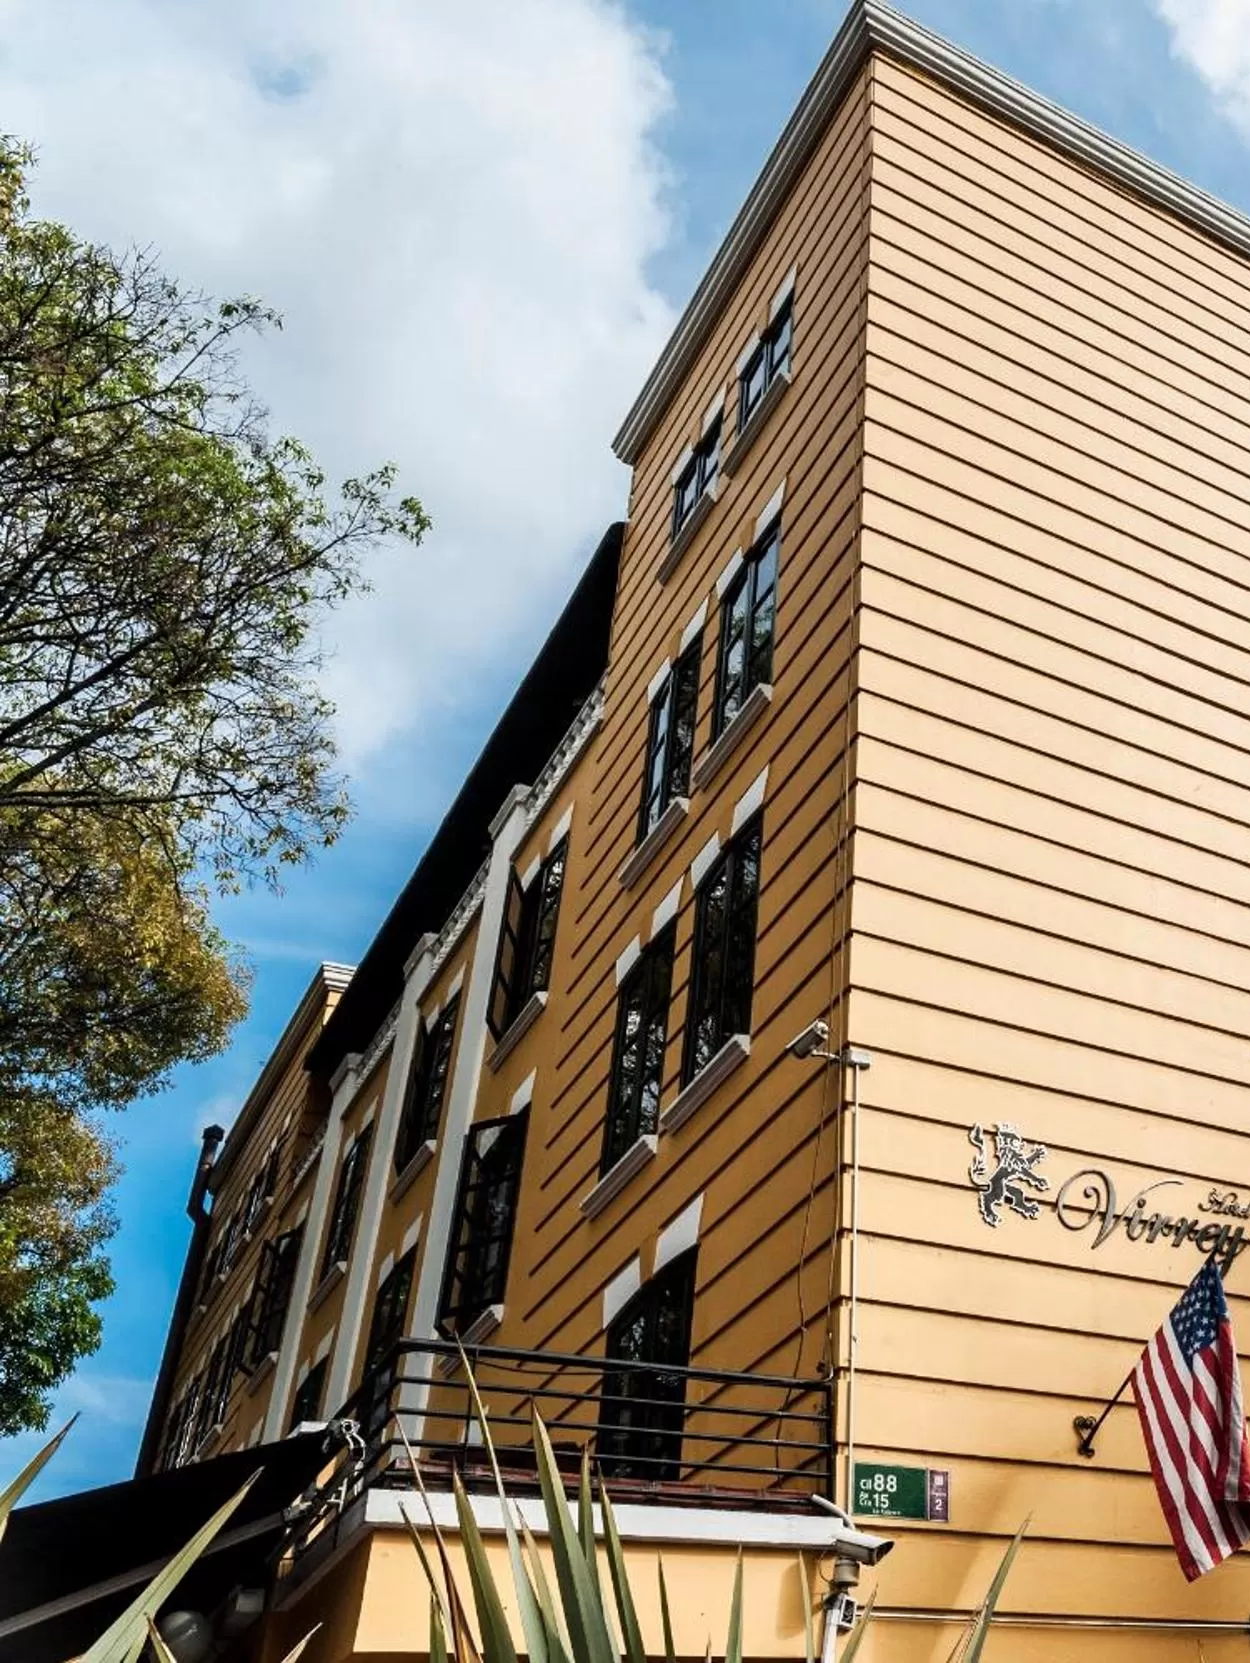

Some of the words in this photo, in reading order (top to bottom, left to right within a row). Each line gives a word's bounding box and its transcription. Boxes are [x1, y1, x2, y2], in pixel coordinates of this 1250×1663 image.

[1056, 1168, 1248, 1278] Virrey
[873, 1473, 897, 1492] 88
[873, 1493, 889, 1508] 15
[935, 1499, 943, 1511] 2
